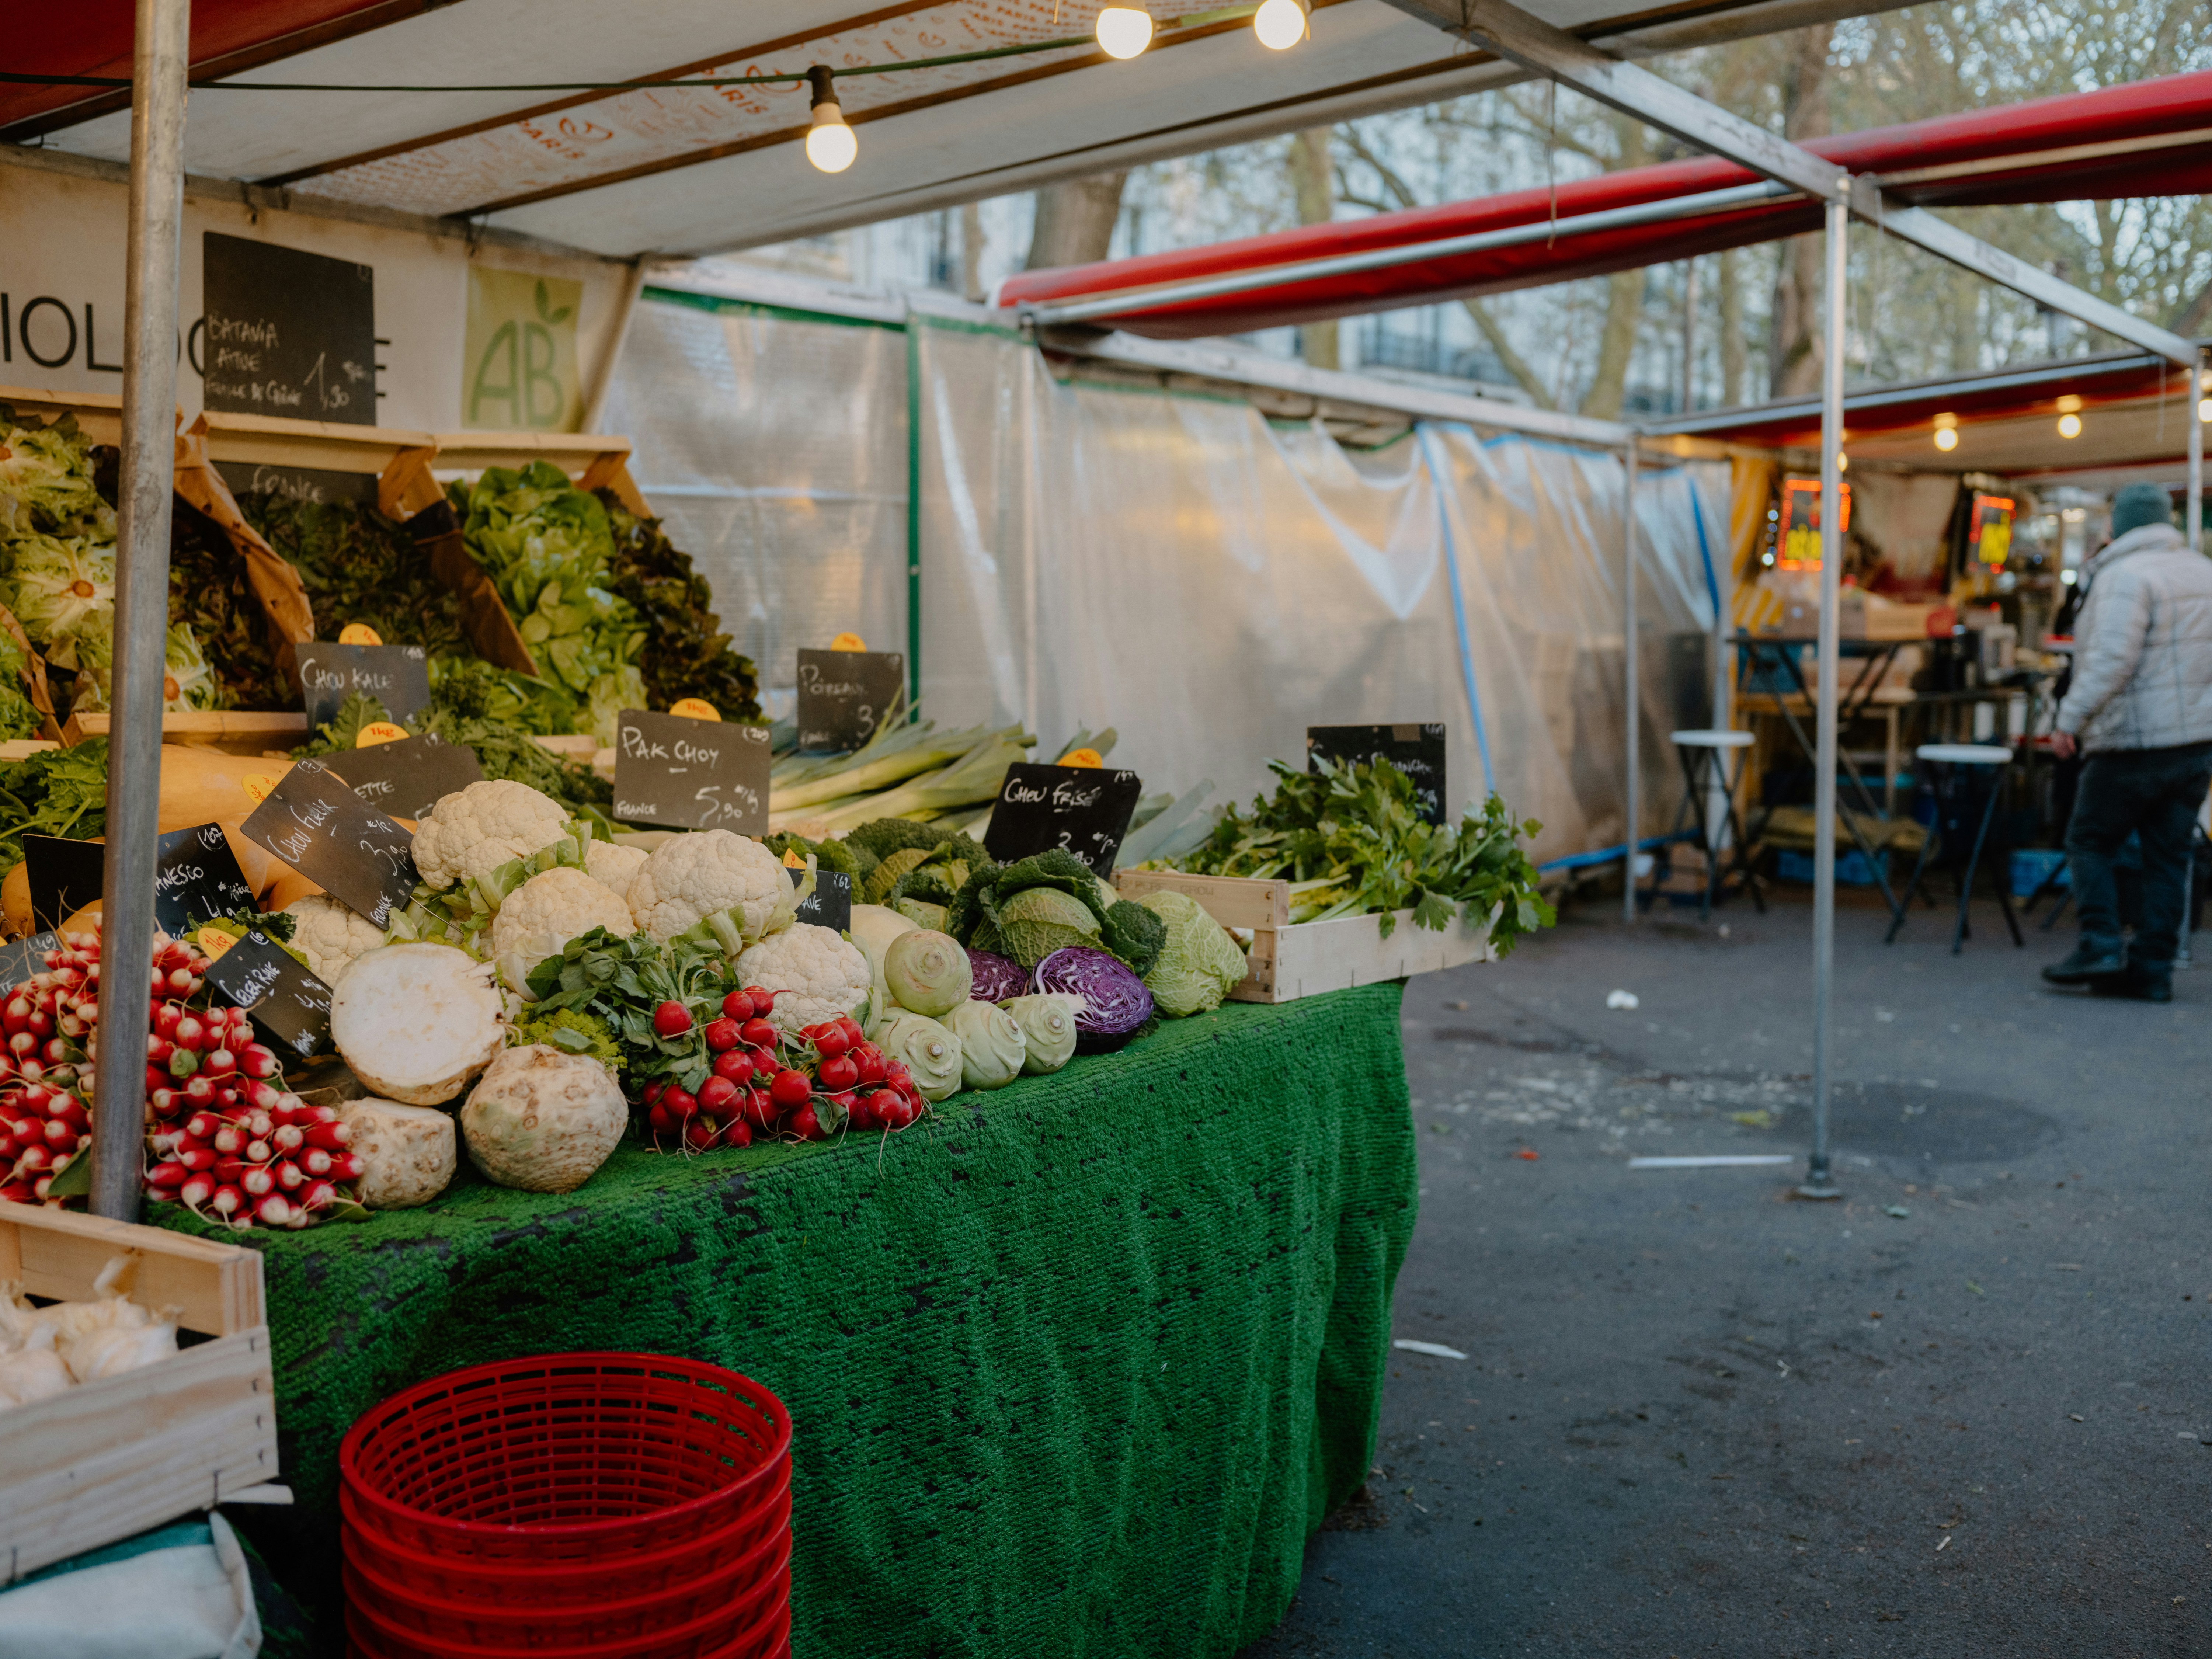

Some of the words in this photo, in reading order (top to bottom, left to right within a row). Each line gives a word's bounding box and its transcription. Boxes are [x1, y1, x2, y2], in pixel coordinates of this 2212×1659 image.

[469, 318, 564, 428] AB
[622, 726, 669, 761] PAK
[674, 740, 719, 769] CHOY
[354, 779, 396, 799] ETTE
[155, 863, 204, 897] ANESCO
[801, 894, 822, 911] AVE
